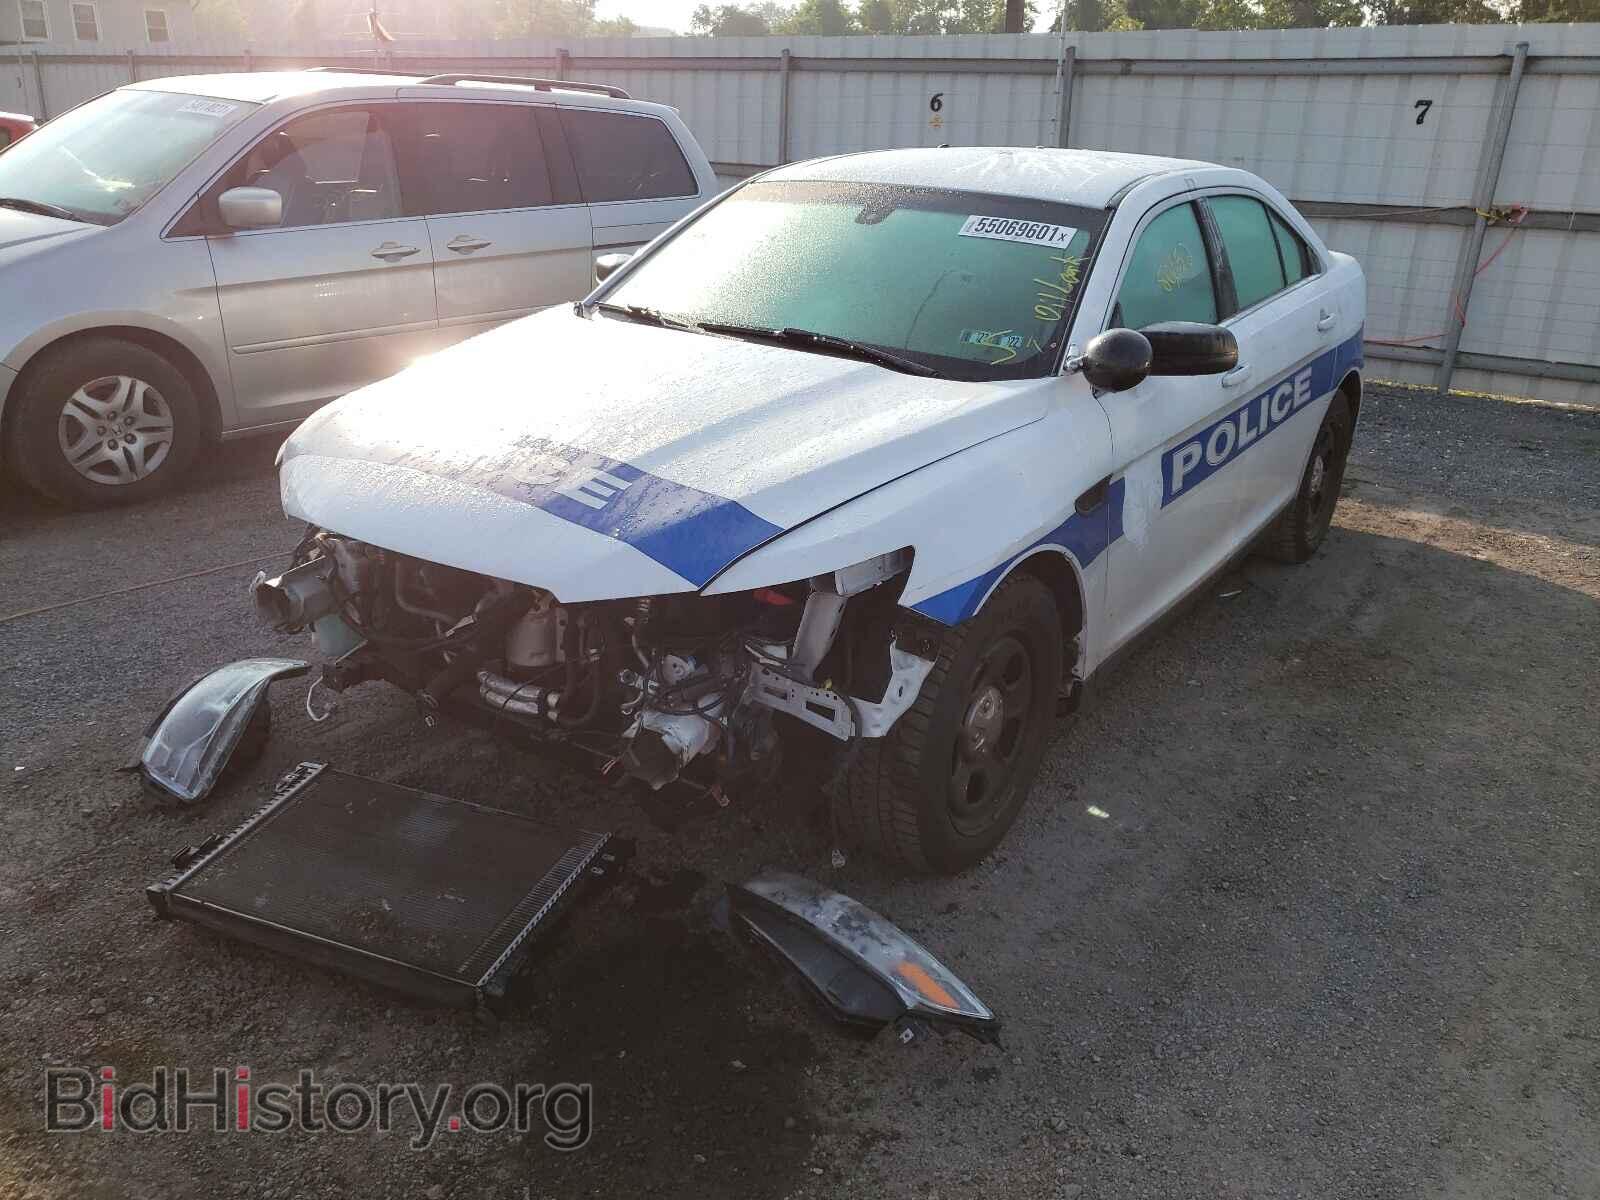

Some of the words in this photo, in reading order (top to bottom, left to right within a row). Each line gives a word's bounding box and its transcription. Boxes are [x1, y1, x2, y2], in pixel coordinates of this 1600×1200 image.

[930, 92, 944, 112] 6
[1414, 99, 1433, 125] 7
[1172, 367, 1313, 496] POLICE
